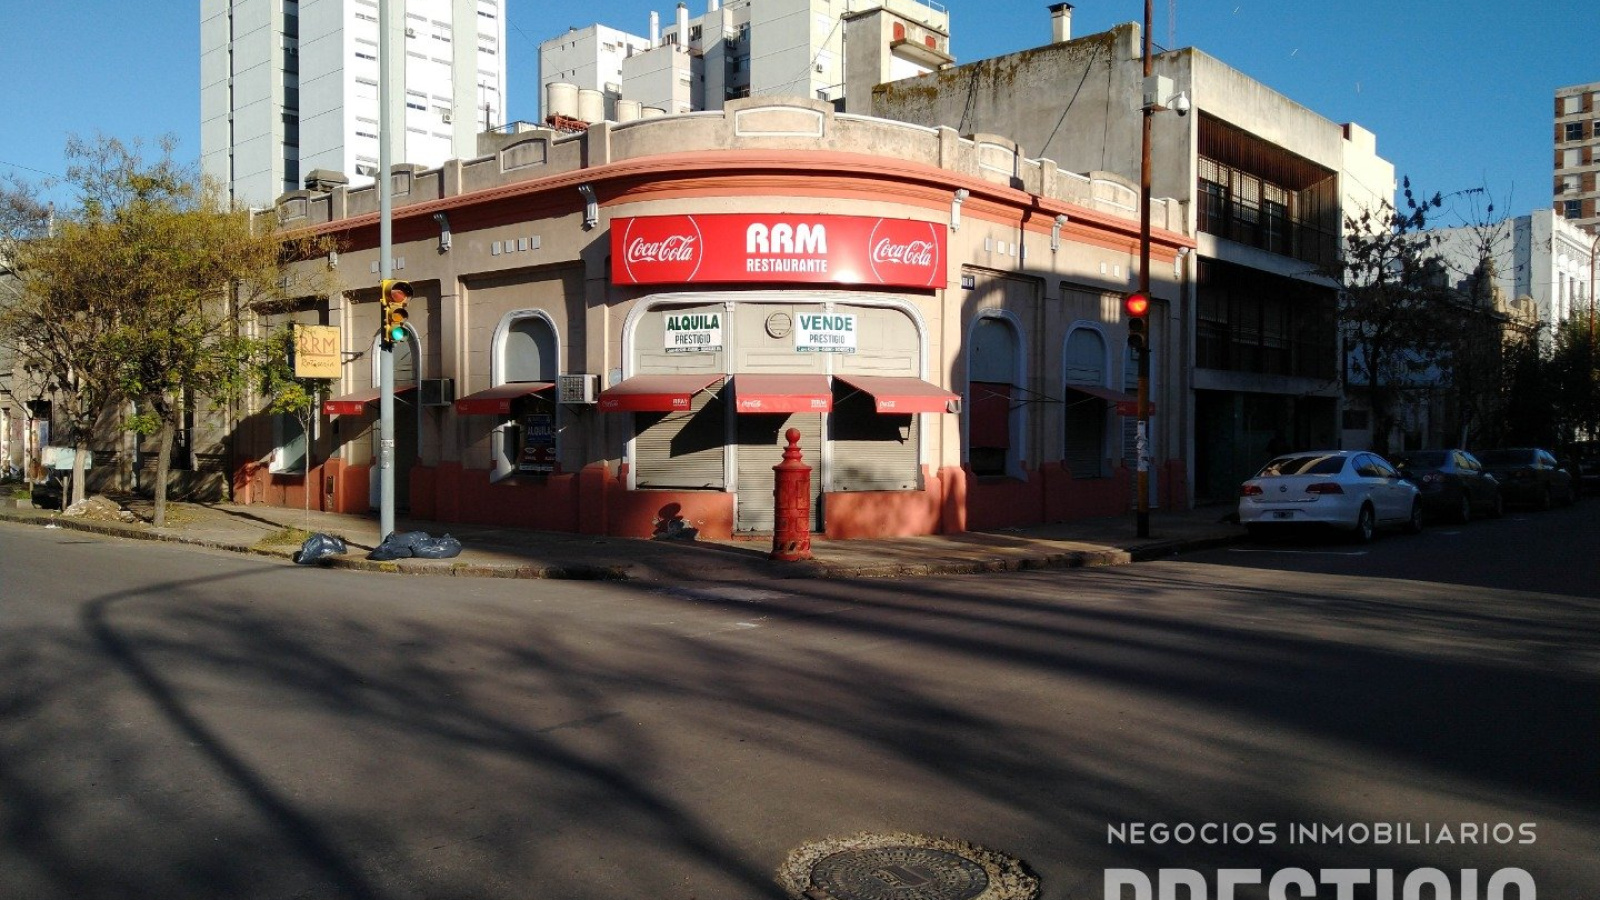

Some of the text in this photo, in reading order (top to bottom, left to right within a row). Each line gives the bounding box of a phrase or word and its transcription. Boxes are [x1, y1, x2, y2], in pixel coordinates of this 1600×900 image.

[746, 223, 827, 252] RRM
[747, 258, 827, 273] RESTAURANTE
[667, 314, 720, 331] ALQUILA
[799, 315, 853, 331] VENDE
[675, 333, 711, 345] PRESTIGIO
[809, 333, 845, 344] PRESTIGIO
